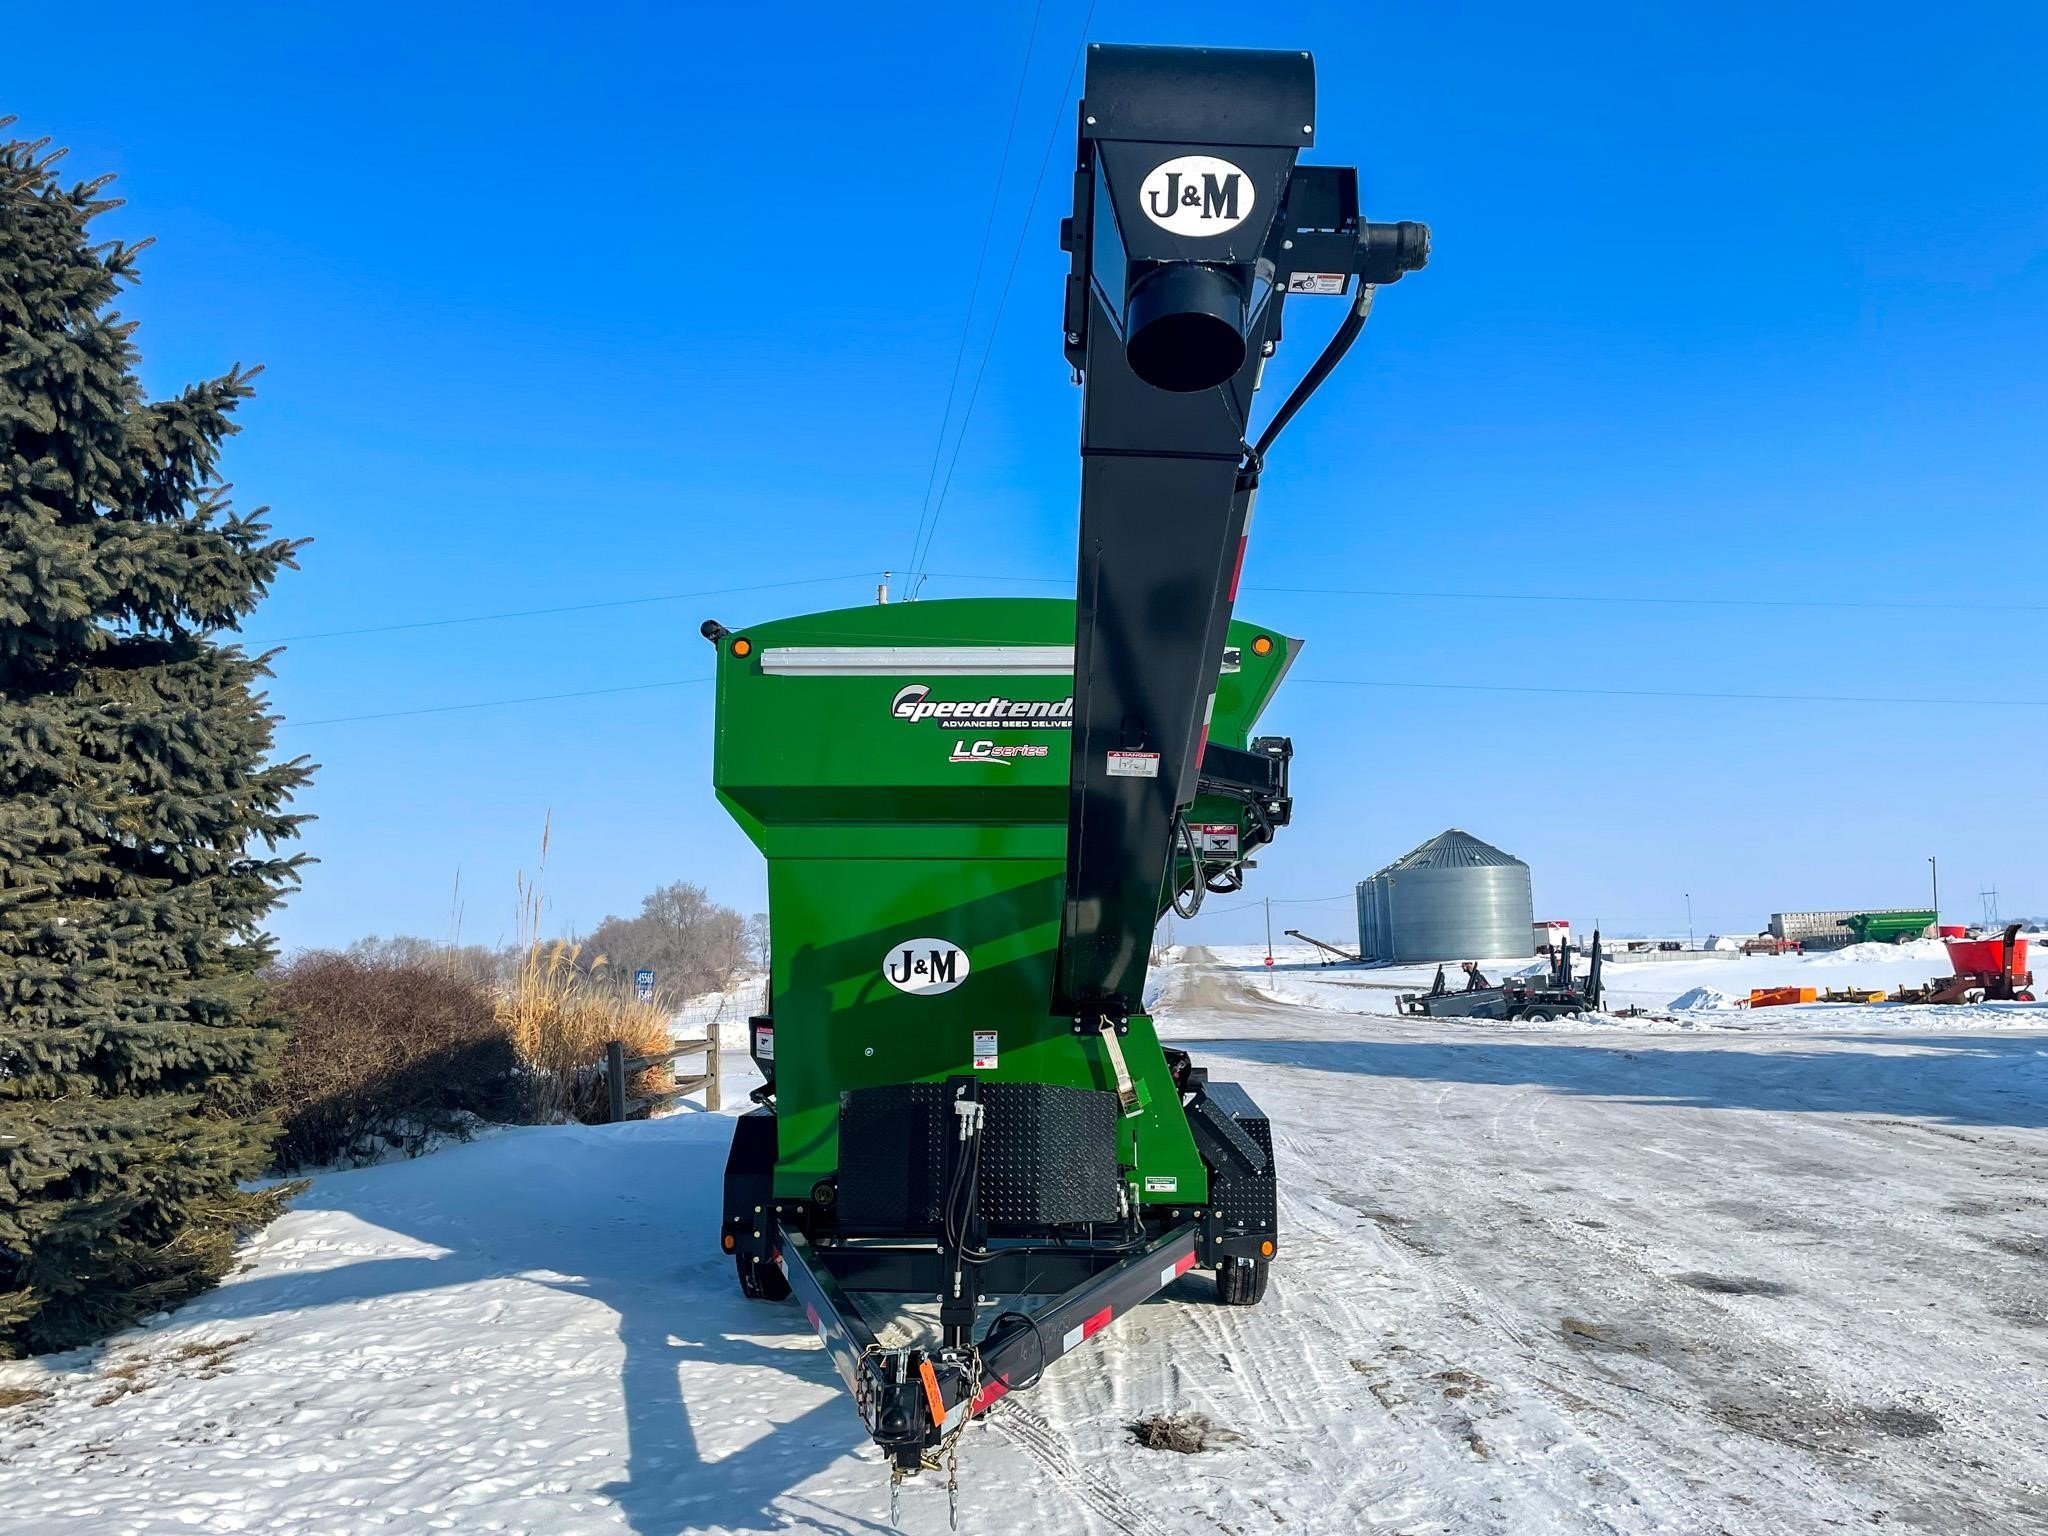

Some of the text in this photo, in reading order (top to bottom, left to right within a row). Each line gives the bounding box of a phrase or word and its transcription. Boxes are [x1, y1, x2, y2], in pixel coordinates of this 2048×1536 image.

[1148, 173, 1241, 219] J&M
[892, 684, 1073, 723] Speedtend
[942, 720, 999, 728] ADVANCED
[1002, 720, 1030, 728] SEED
[890, 950, 958, 983] J&M
